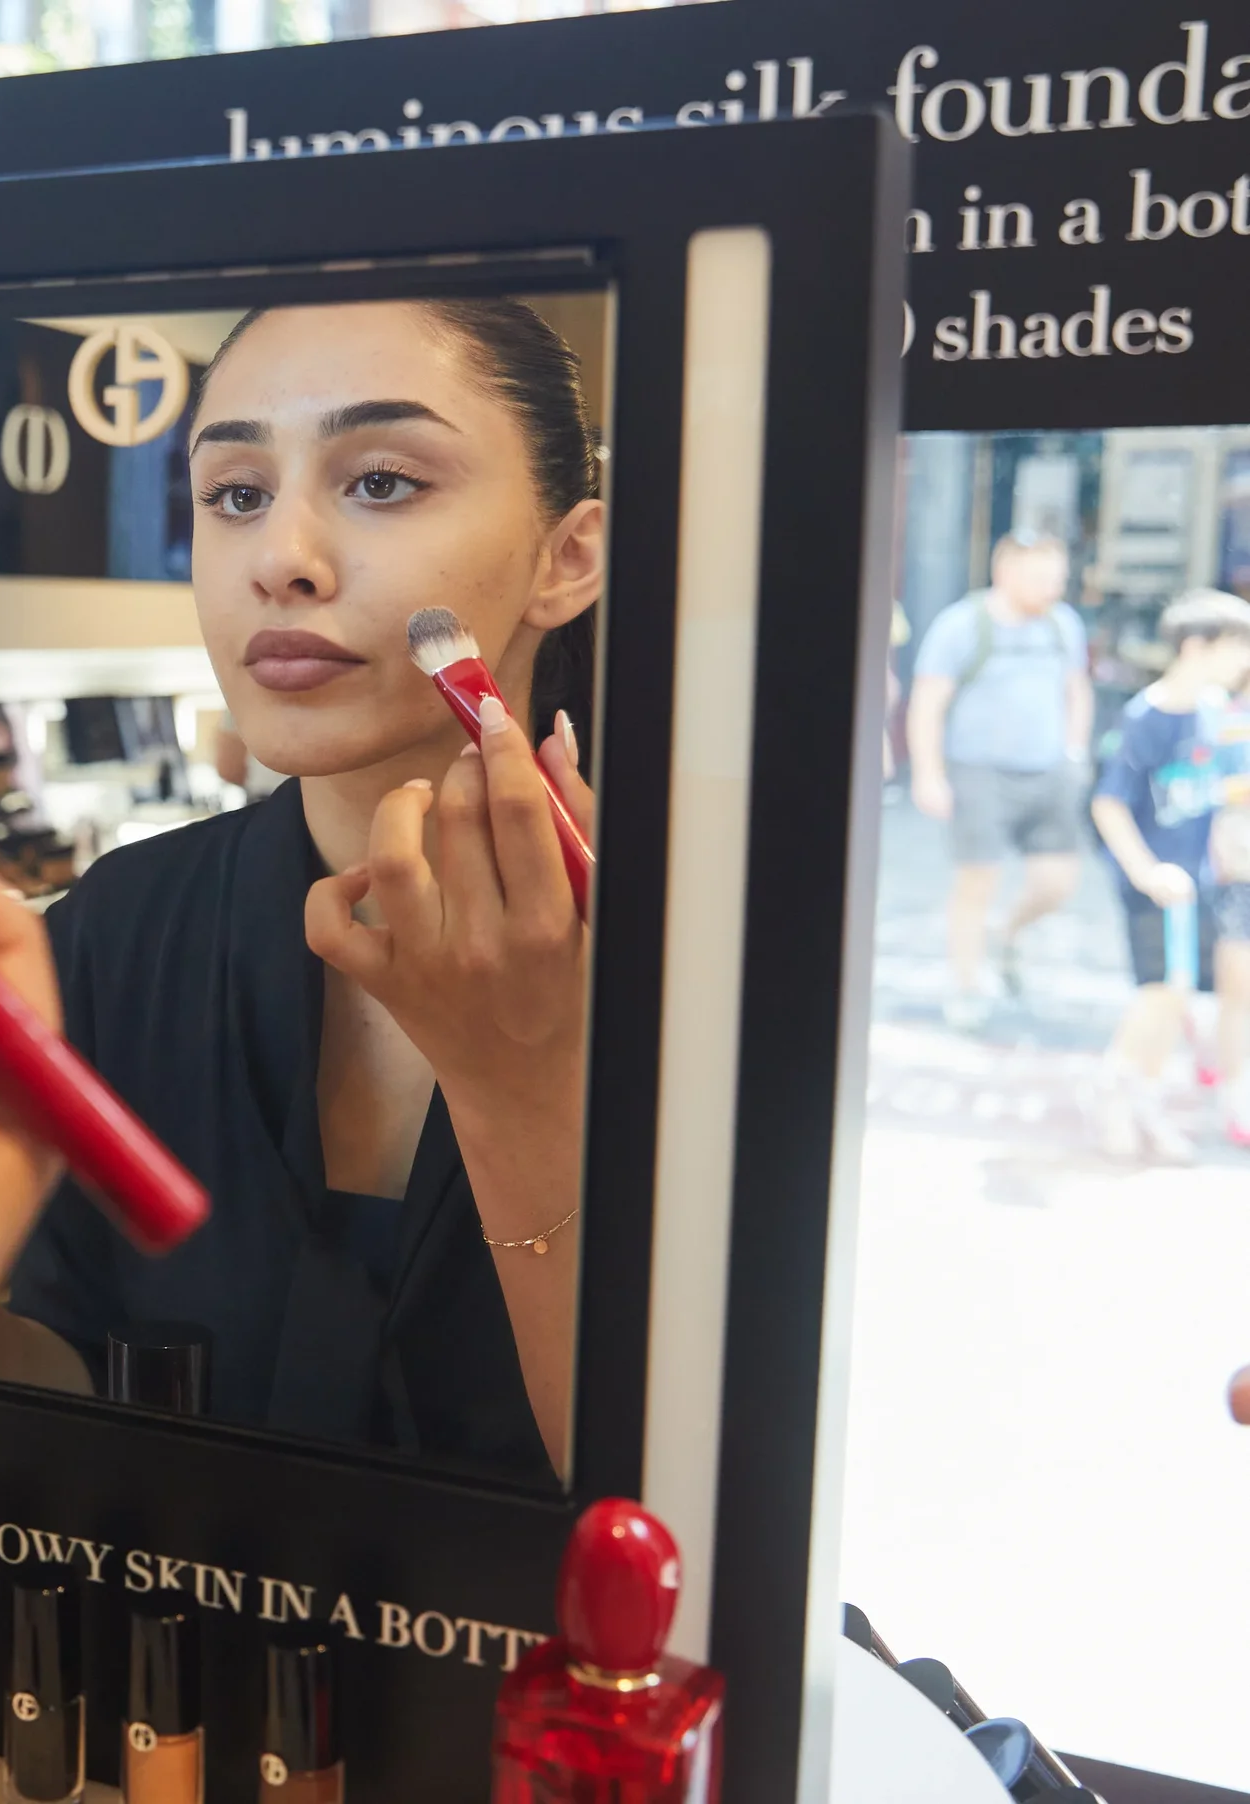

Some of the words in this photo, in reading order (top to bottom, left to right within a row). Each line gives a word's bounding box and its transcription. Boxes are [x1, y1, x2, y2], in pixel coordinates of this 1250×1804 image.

[957, 184, 1038, 251] in
[1058, 198, 1105, 246] a
[932, 283, 1194, 362] shades
[124, 1550, 247, 1614] SKIN
[258, 1576, 316, 1624] IN
[329, 1592, 366, 1640] A
[376, 1599, 551, 1673] BOTT
